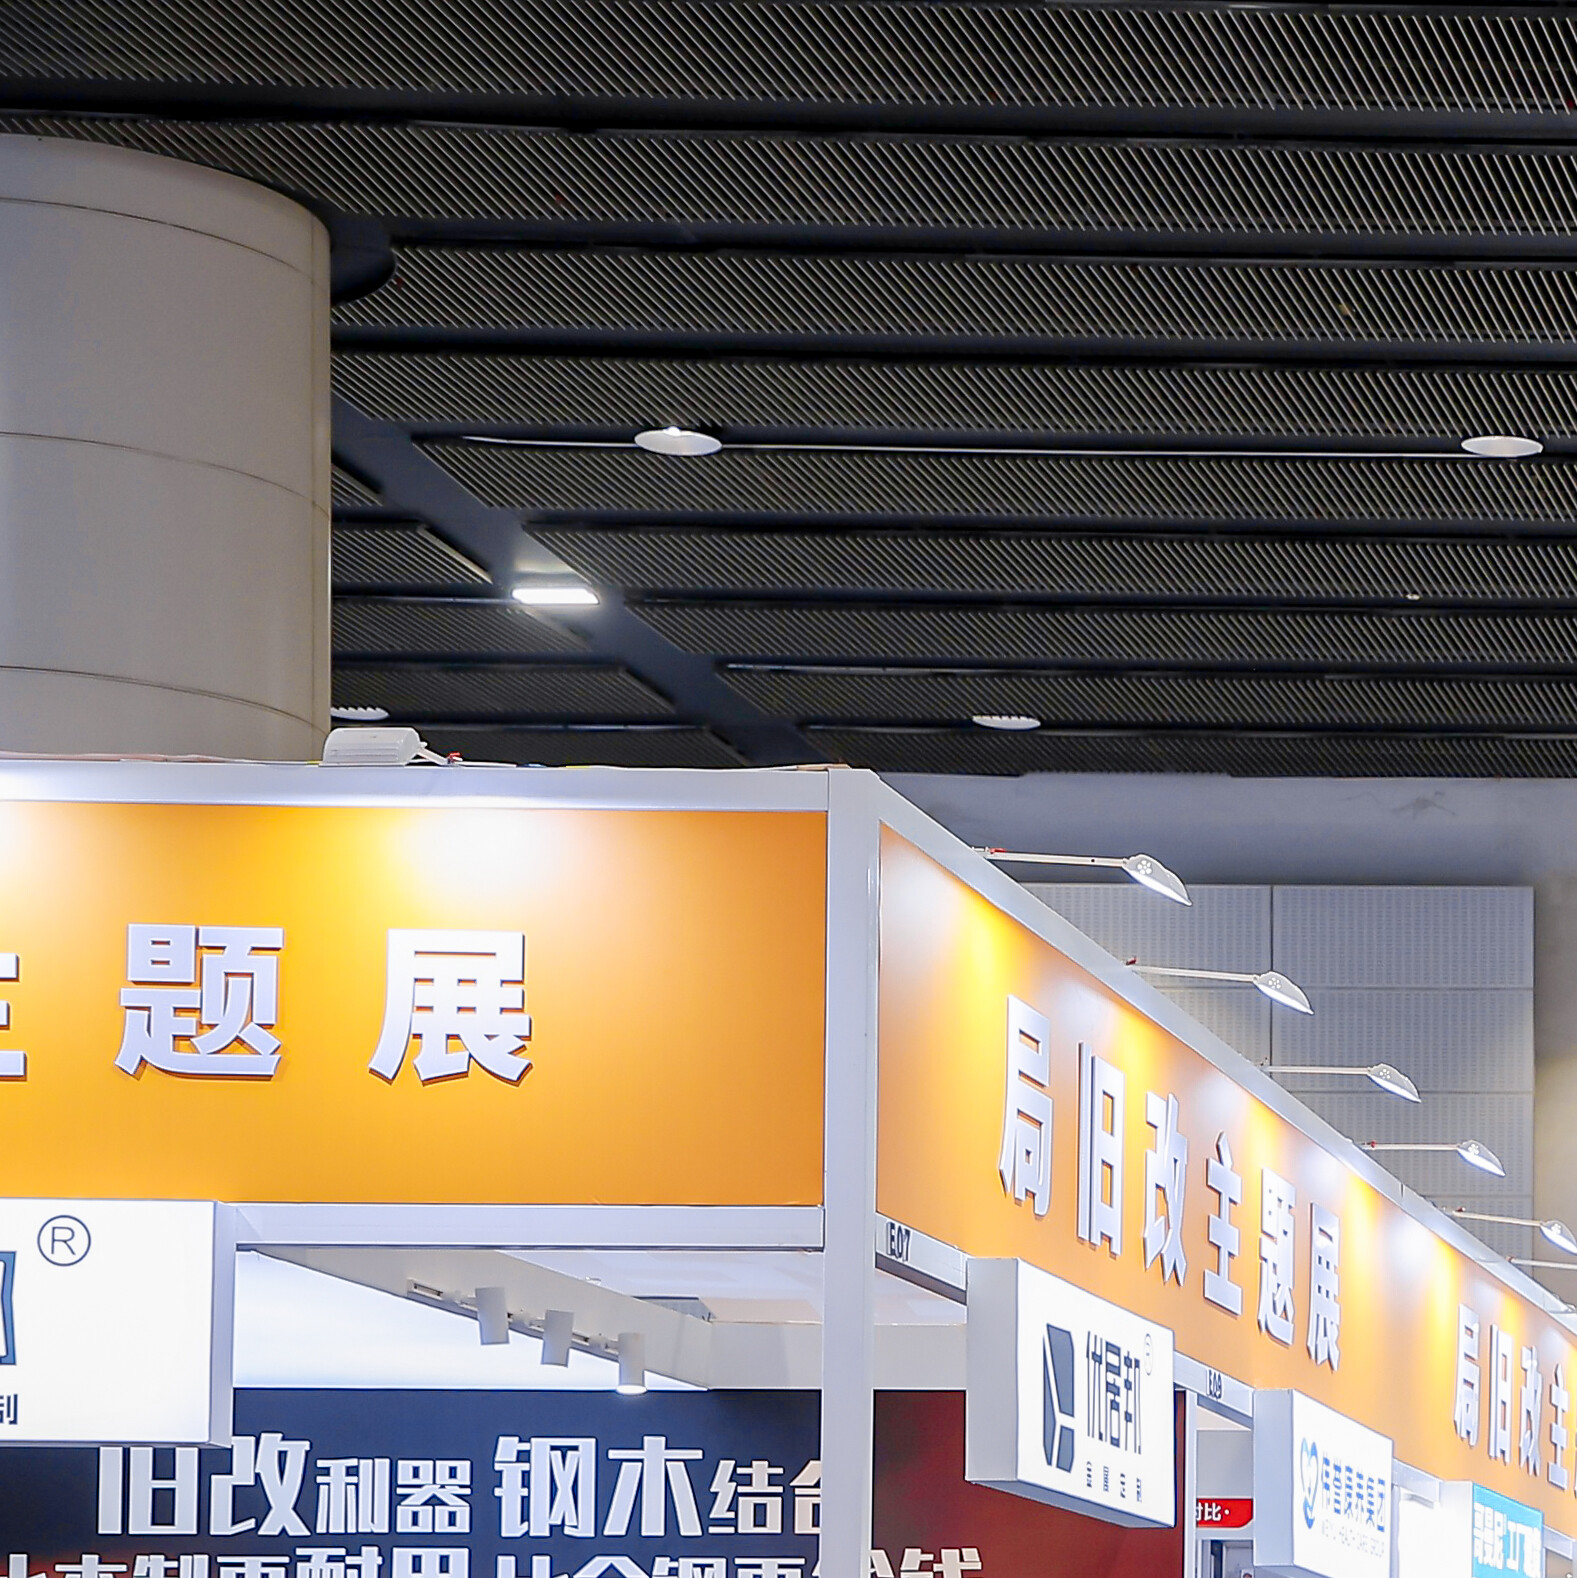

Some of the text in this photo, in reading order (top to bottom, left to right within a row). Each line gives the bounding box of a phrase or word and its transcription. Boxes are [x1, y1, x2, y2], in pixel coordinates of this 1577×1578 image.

[997, 994, 1342, 1372] 局旧改主题展
[886, 1222, 910, 1262] E07
[97, 1432, 472, 1537] 旧改利器
